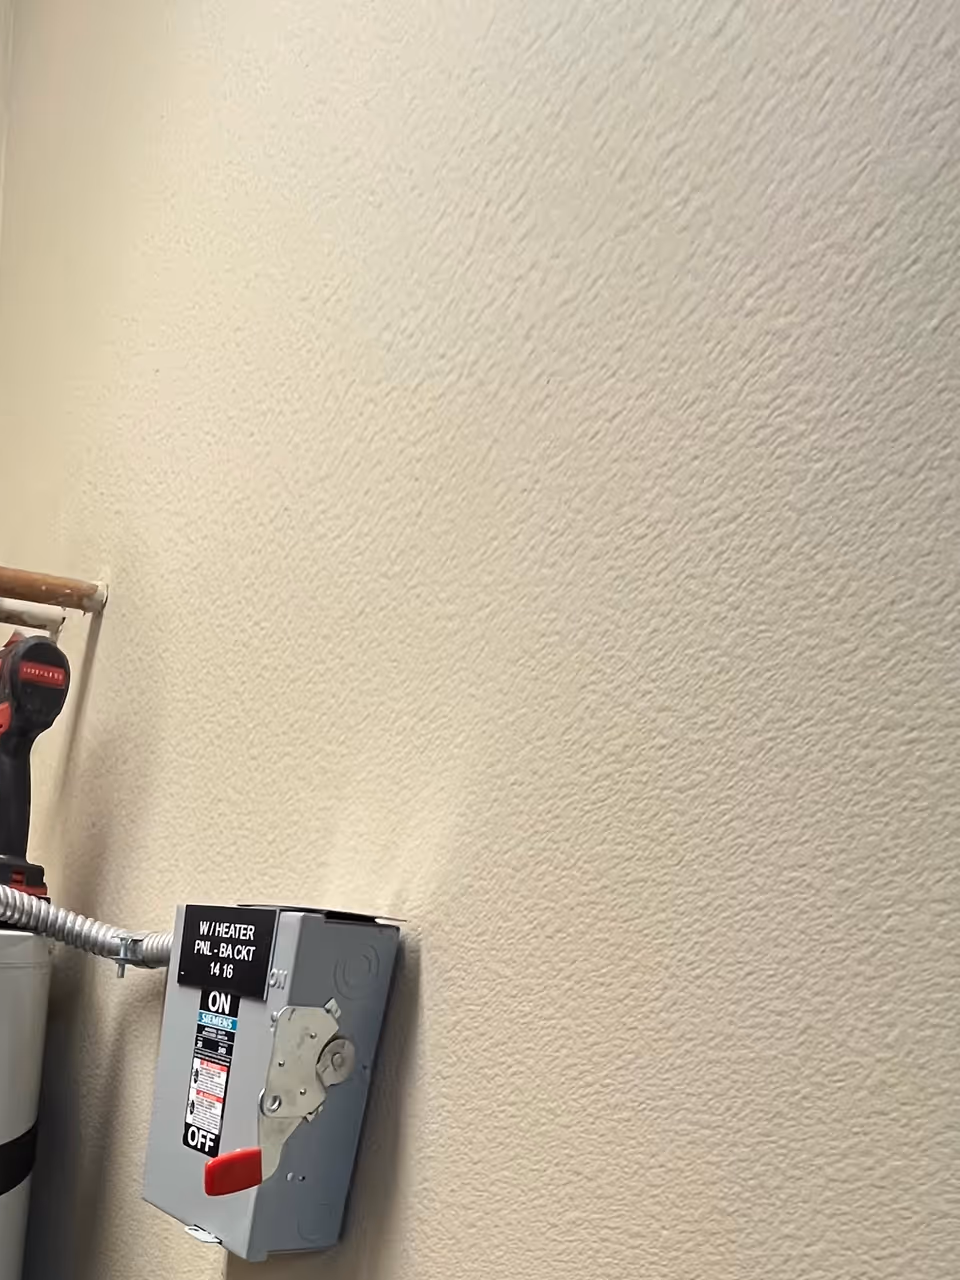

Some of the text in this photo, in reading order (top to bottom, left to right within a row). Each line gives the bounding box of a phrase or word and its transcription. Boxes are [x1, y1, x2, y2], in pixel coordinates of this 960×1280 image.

[210, 961, 234, 979] 14 16
[269, 968, 288, 990] ON
[208, 990, 231, 1015] ON
[200, 1012, 233, 1030] SIEMENS
[187, 1125, 216, 1152] OFF
